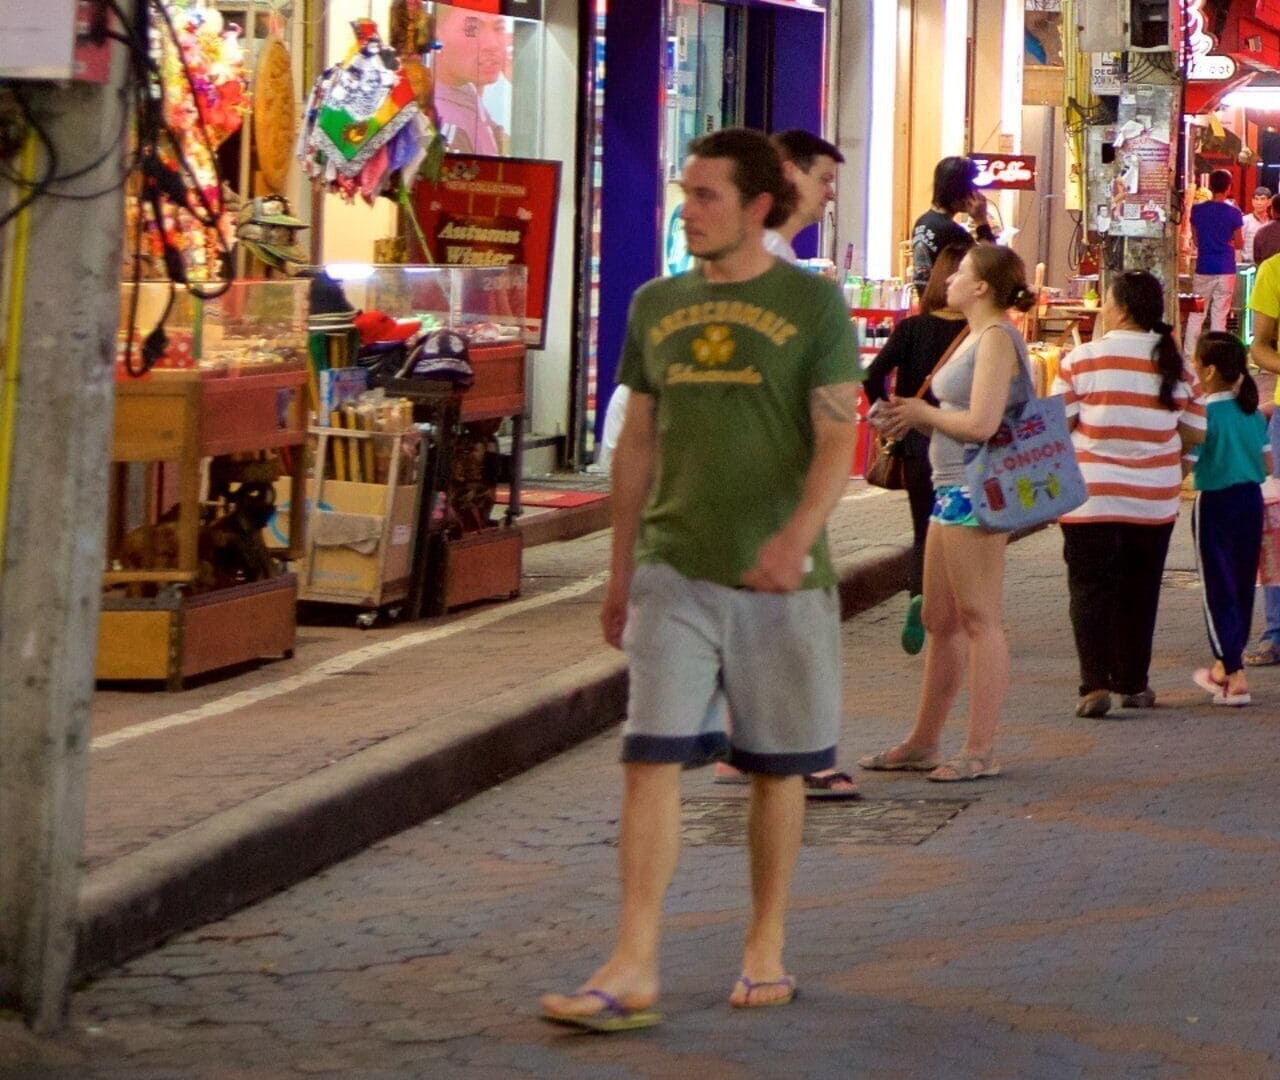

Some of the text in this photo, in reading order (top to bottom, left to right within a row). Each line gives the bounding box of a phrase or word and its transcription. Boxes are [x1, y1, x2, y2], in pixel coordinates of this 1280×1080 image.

[437, 221, 522, 245] Autumn
[446, 245, 516, 265] Winter
[991, 440, 1068, 475] LONDON
